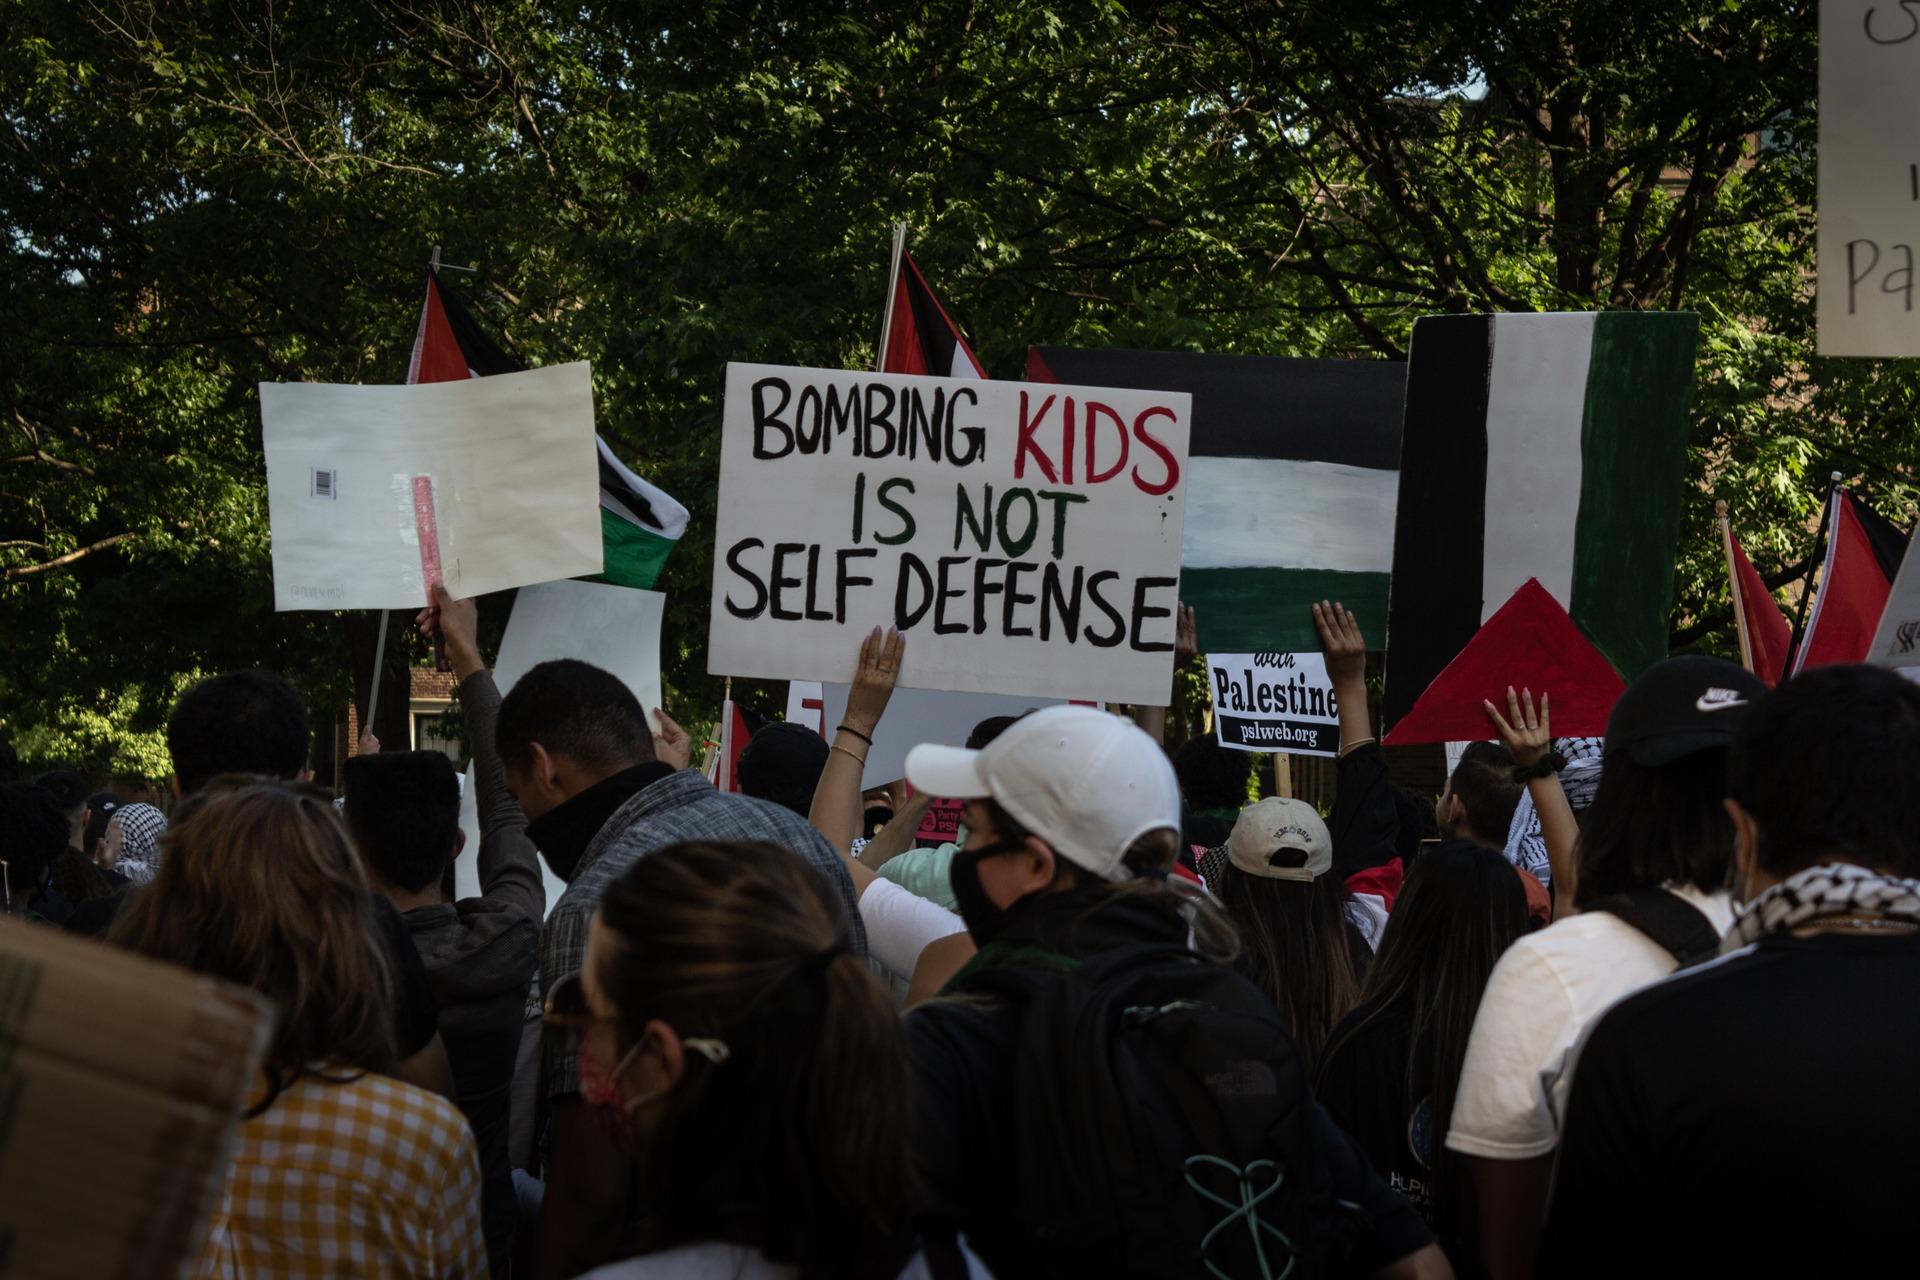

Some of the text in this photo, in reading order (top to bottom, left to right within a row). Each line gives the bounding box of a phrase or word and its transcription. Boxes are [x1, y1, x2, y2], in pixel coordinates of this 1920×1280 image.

[751, 376, 1181, 496] BOMBING KIDS
[852, 471, 1090, 560] IS NOT
[724, 536, 1178, 653] SELF DEFENSE
[1213, 667, 1339, 719] Palestine
[1240, 720, 1318, 748] pslweb.org
